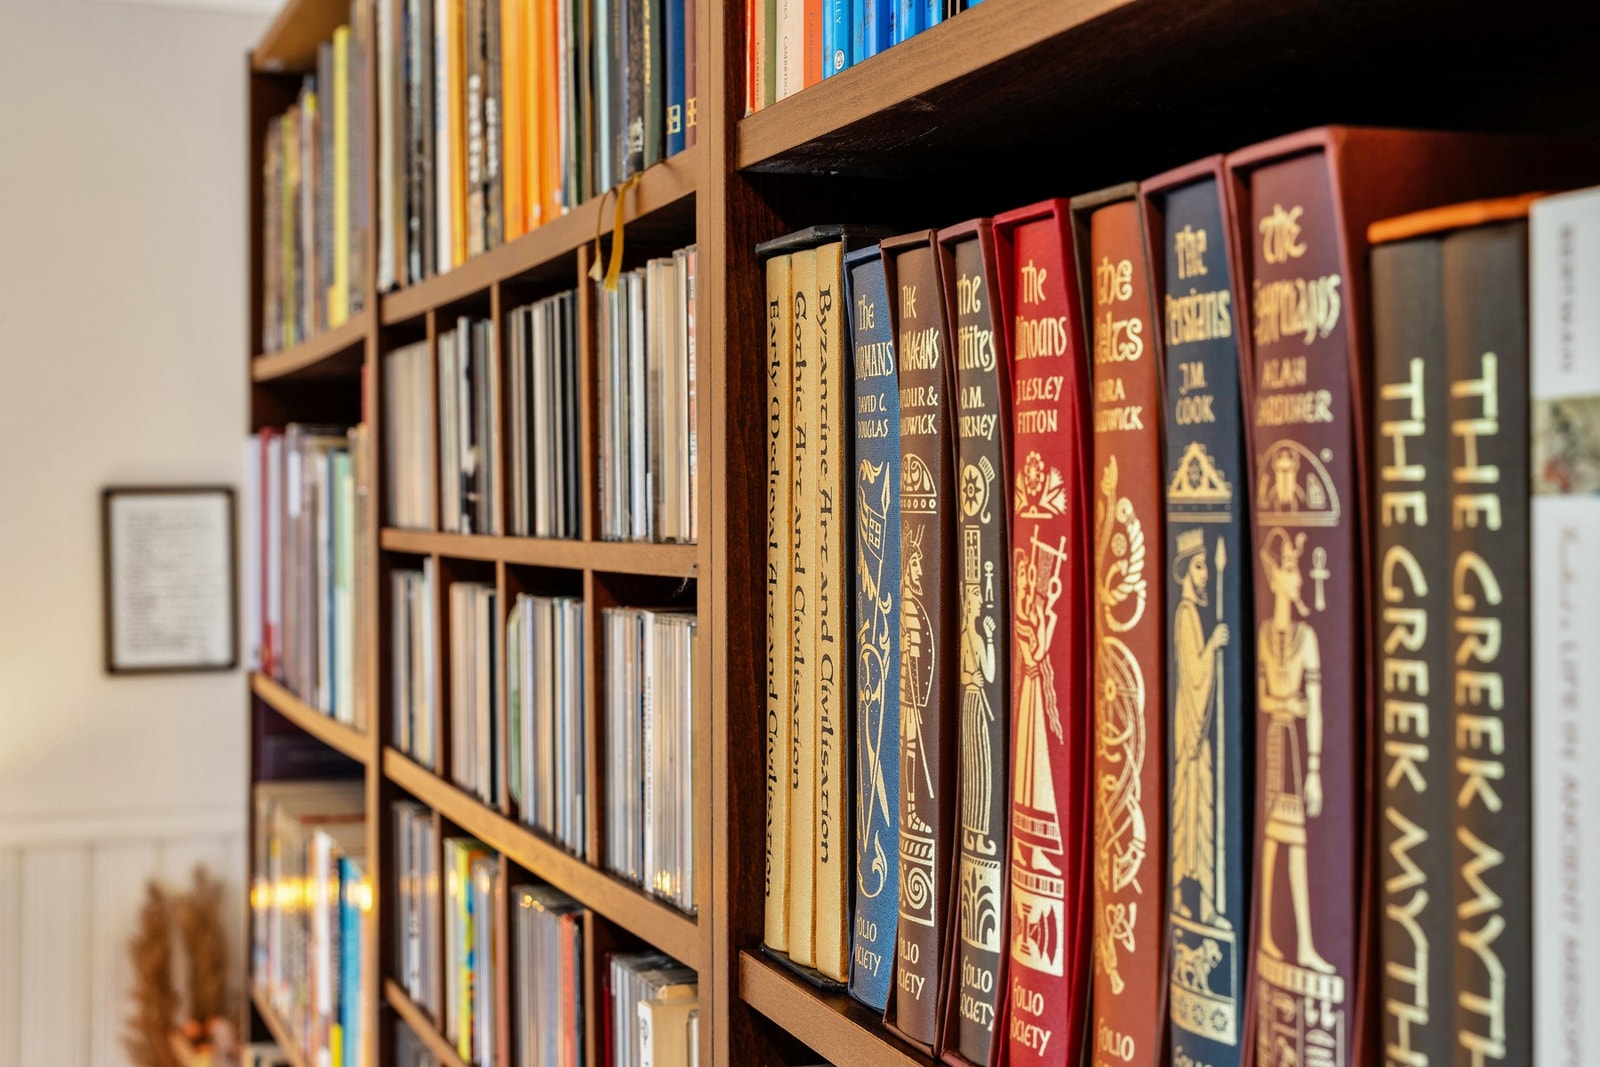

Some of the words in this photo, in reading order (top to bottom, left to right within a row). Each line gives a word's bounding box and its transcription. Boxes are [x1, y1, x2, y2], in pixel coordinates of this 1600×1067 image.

[768, 296, 781, 388] Early
[902, 284, 917, 319] THE
[793, 290, 807, 413] Gothic
[816, 284, 832, 482] Byzantine
[927, 385, 939, 407] &
[1021, 376, 1064, 402] LESLEY
[792, 416, 808, 497] Art
[1018, 409, 1058, 434] FITTON
[1175, 395, 1216, 426] COOK
[1380, 357, 1427, 527] THE
[1450, 352, 1501, 531] THE
[768, 397, 781, 550] Medieval
[793, 505, 806, 573] and
[815, 484, 833, 564] Art
[766, 555, 780, 628] Art
[819, 571, 833, 643] and
[766, 636, 780, 701] and
[792, 585, 806, 790] Civilisation
[1381, 545, 1430, 793] GREEK
[1453, 551, 1505, 813] GREEK
[765, 709, 779, 898] Civilisation
[820, 653, 834, 864] Civilisation
[1385, 806, 1429, 1067] MYTH
